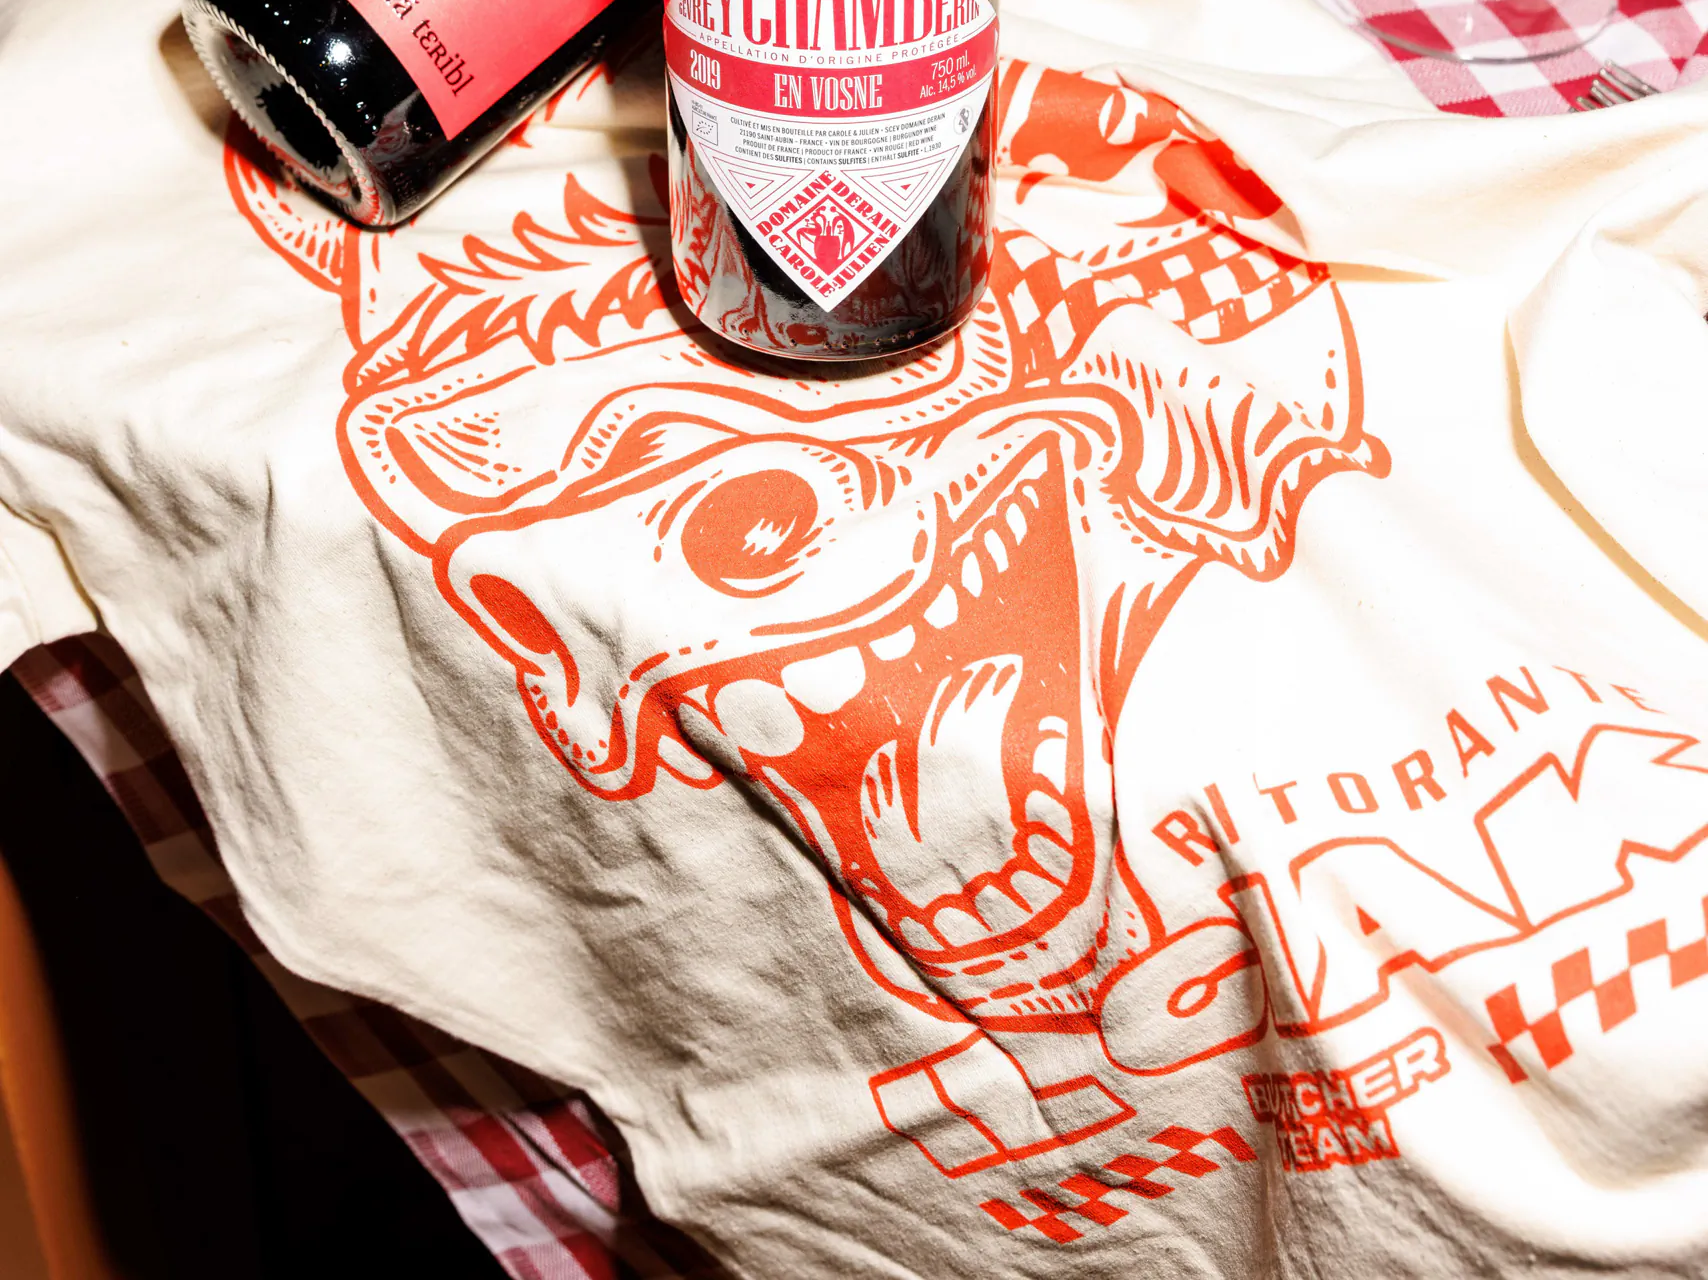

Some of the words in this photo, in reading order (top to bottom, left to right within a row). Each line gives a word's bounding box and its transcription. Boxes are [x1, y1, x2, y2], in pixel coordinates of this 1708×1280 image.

[699, 33, 789, 62] APPELLATION
[799, 53, 888, 65] D'ORIGINE
[892, 33, 959, 60] PROTÉGÉE
[931, 57, 954, 80] 750
[956, 50, 970, 71] ml.
[690, 49, 721, 90] 2019
[919, 84, 936, 99] Alc.
[938, 75, 956, 94] 14,5
[957, 71, 965, 84] %
[965, 64, 976, 80] vol.
[774, 73, 802, 107] EN
[810, 74, 883, 111] VOSNE
[730, 116, 751, 129] CULTIVÉ
[760, 124, 771, 132] MIS
[781, 128, 813, 136] BOUTEILLE
[859, 128, 880, 136] JULIEN
[901, 118, 926, 130] DOMAINE
[927, 112, 946, 124] DERAIN
[739, 128, 757, 138] 21190
[757, 133, 793, 144] SAINT-AUBIN
[851, 135, 888, 145] BOURGOGNE
[892, 129, 923, 141] BURGUNDY
[924, 124, 937, 134] WINE
[735, 146, 761, 158] CONTIENT
[762, 152, 774, 161] DES
[774, 154, 803, 164] SULFITES
[807, 157, 837, 165] CONTAINS
[838, 157, 867, 165] SULFITES
[897, 148, 920, 159] SULFITE
[742, 138, 766, 149] PRODUIT
[777, 145, 800, 154] FRANCE
[805, 148, 833, 156] PRODUCT
[834, 148, 842, 156] OF
[844, 147, 867, 155] FRANCE
[884, 142, 904, 151] ROUGE
[908, 139, 920, 147] RED
[920, 135, 934, 144] WINE
[755, 170, 836, 238] DOMAINE
[831, 180, 901, 239] DERAIN
[768, 233, 833, 298] CAROLE
[833, 233, 892, 294] JULIEN
[1245, 1029, 1447, 1122] BUTCHER
[1275, 1118, 1397, 1168] TEAM
